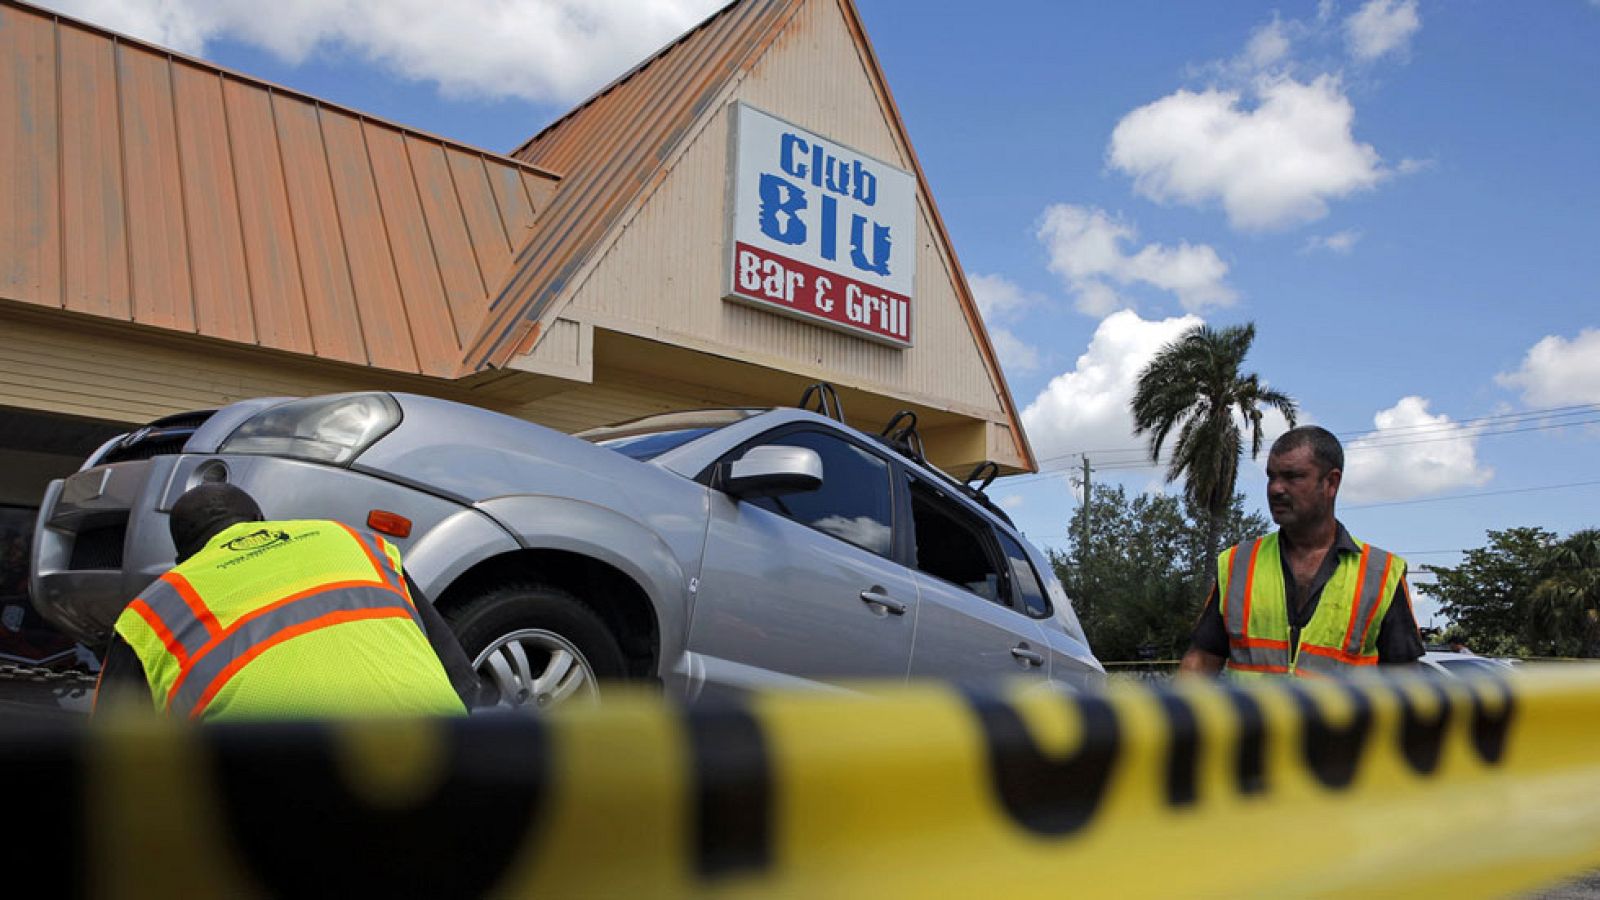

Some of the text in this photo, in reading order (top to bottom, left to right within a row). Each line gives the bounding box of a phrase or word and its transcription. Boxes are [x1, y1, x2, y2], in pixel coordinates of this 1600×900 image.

[780, 132, 876, 206] Club
[738, 250, 907, 336] Bar & Grill
